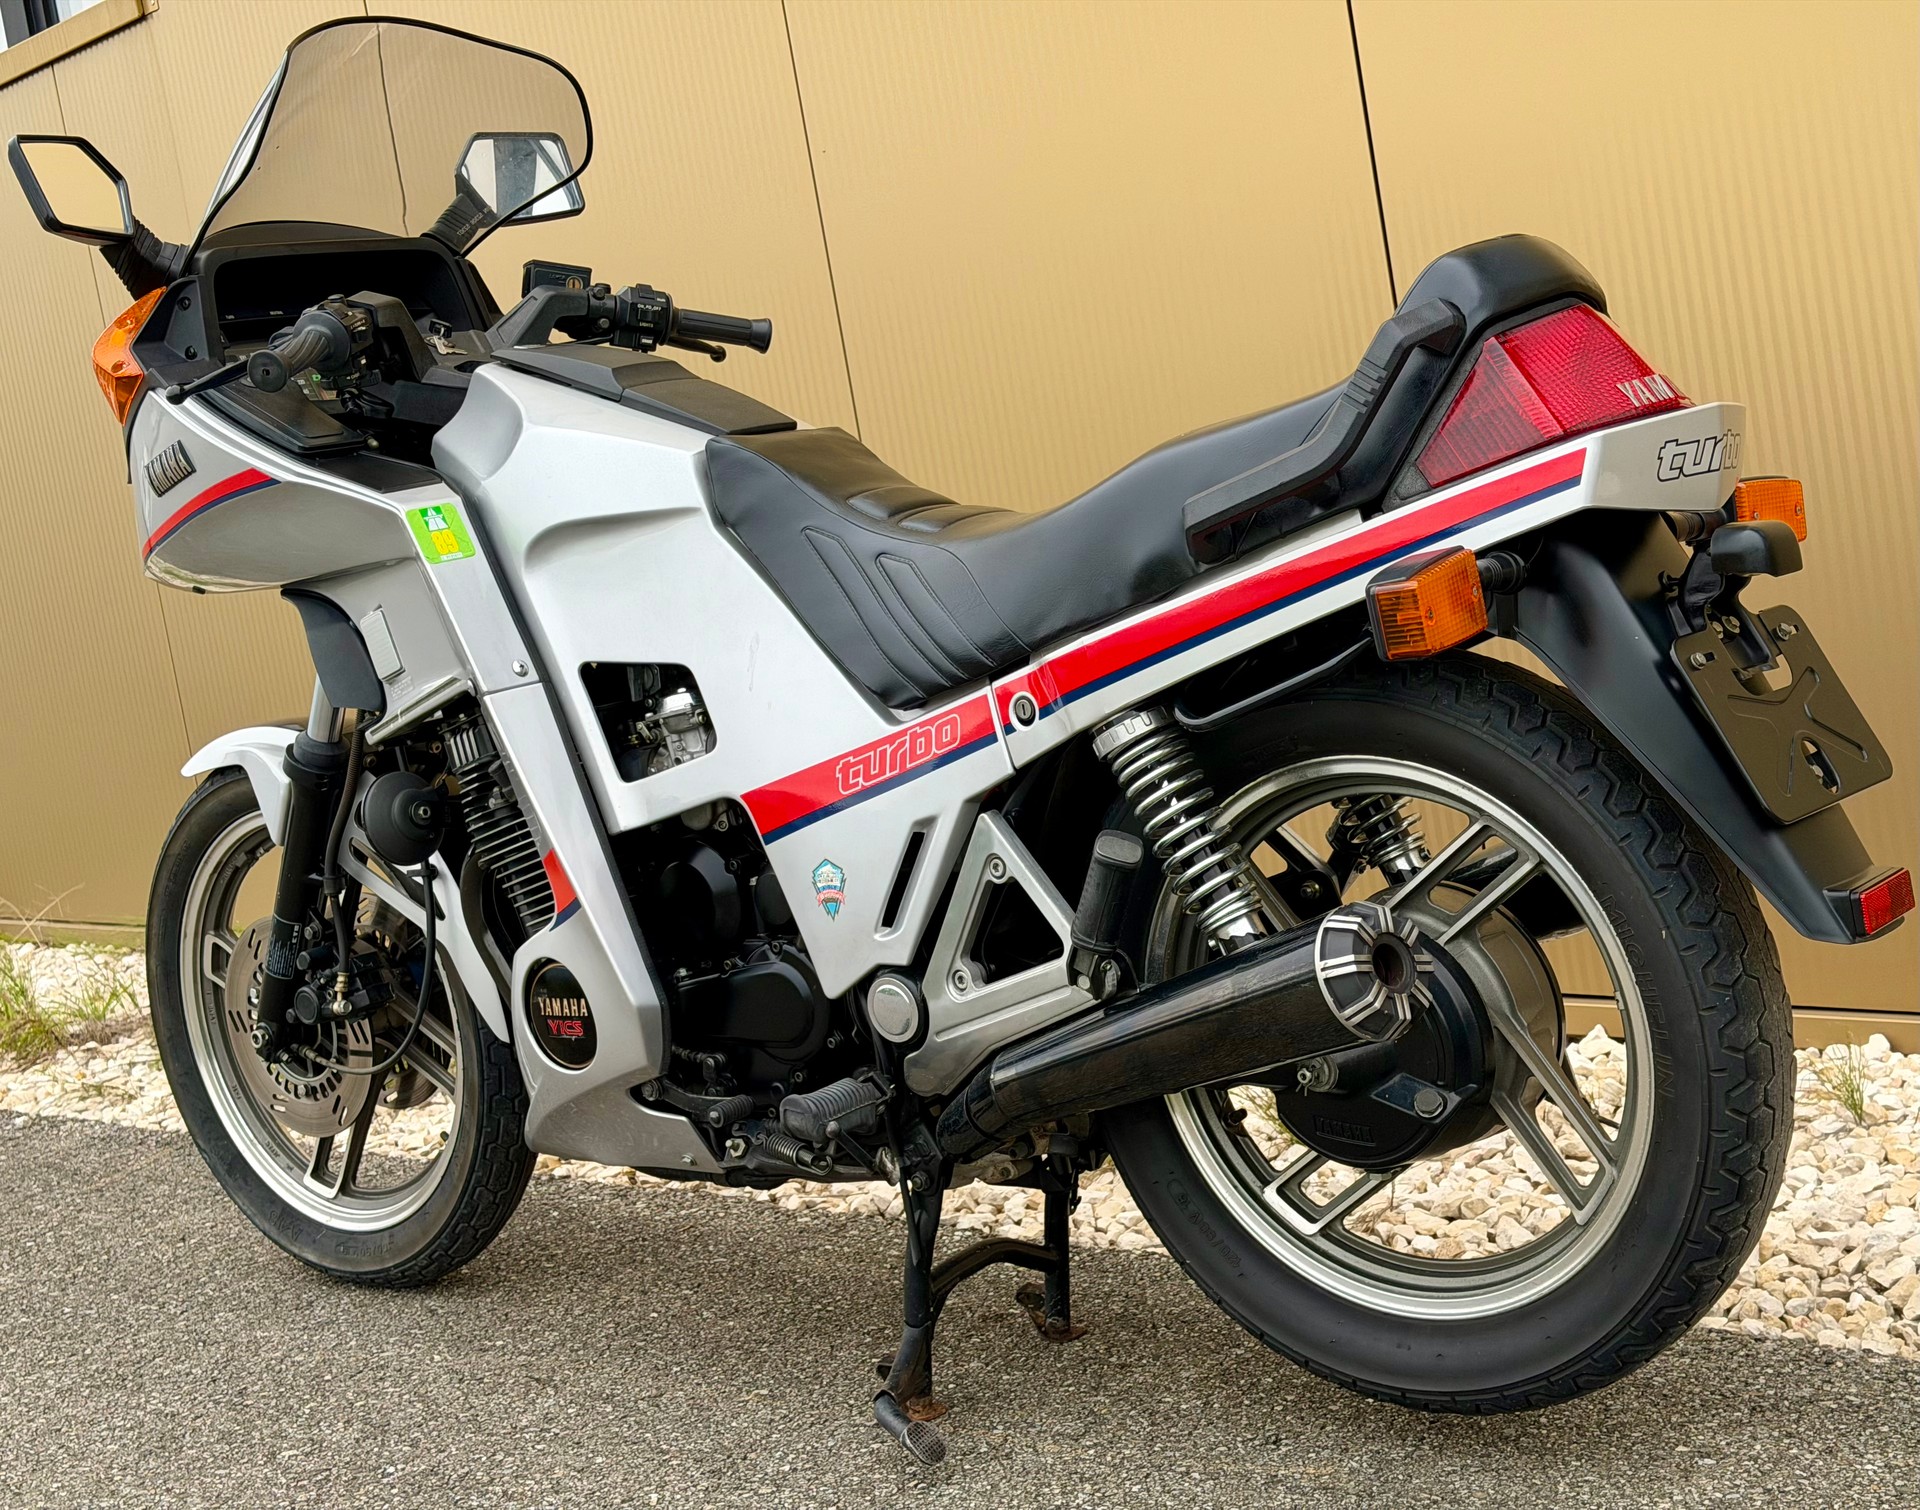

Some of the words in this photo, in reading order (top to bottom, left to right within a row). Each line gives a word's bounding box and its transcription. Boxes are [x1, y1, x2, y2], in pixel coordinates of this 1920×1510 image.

[1657, 429, 1741, 482] turbo
[836, 714, 960, 795] turbo
[538, 997, 588, 1016] YAMAHA
[1601, 895, 1675, 1098] MICHELIN
